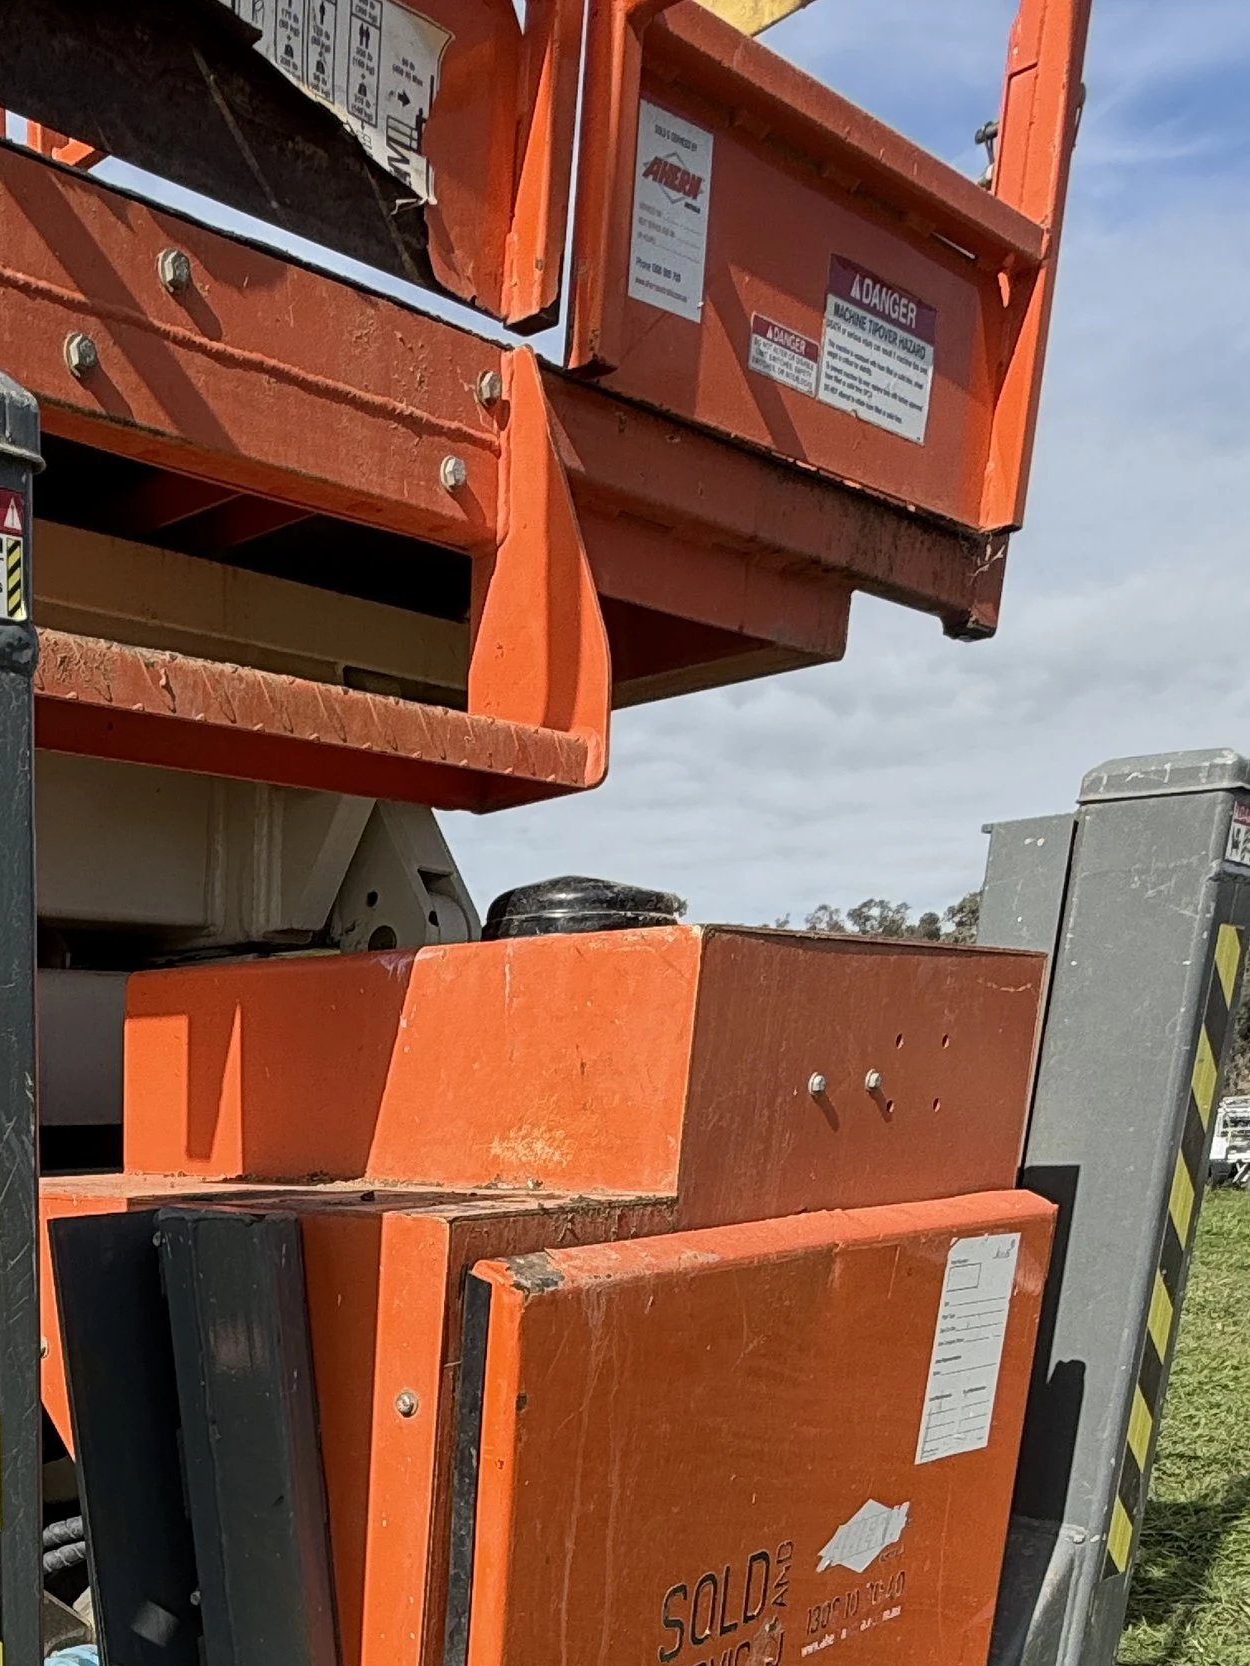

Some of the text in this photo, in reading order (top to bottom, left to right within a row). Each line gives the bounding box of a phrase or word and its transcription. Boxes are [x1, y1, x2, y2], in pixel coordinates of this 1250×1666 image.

[642, 156, 703, 200] AHERN
[863, 278, 917, 329] DANGER
[774, 326, 806, 355] DANGER
[658, 1550, 770, 1662] SOLD
[772, 1540, 794, 1607] AND
